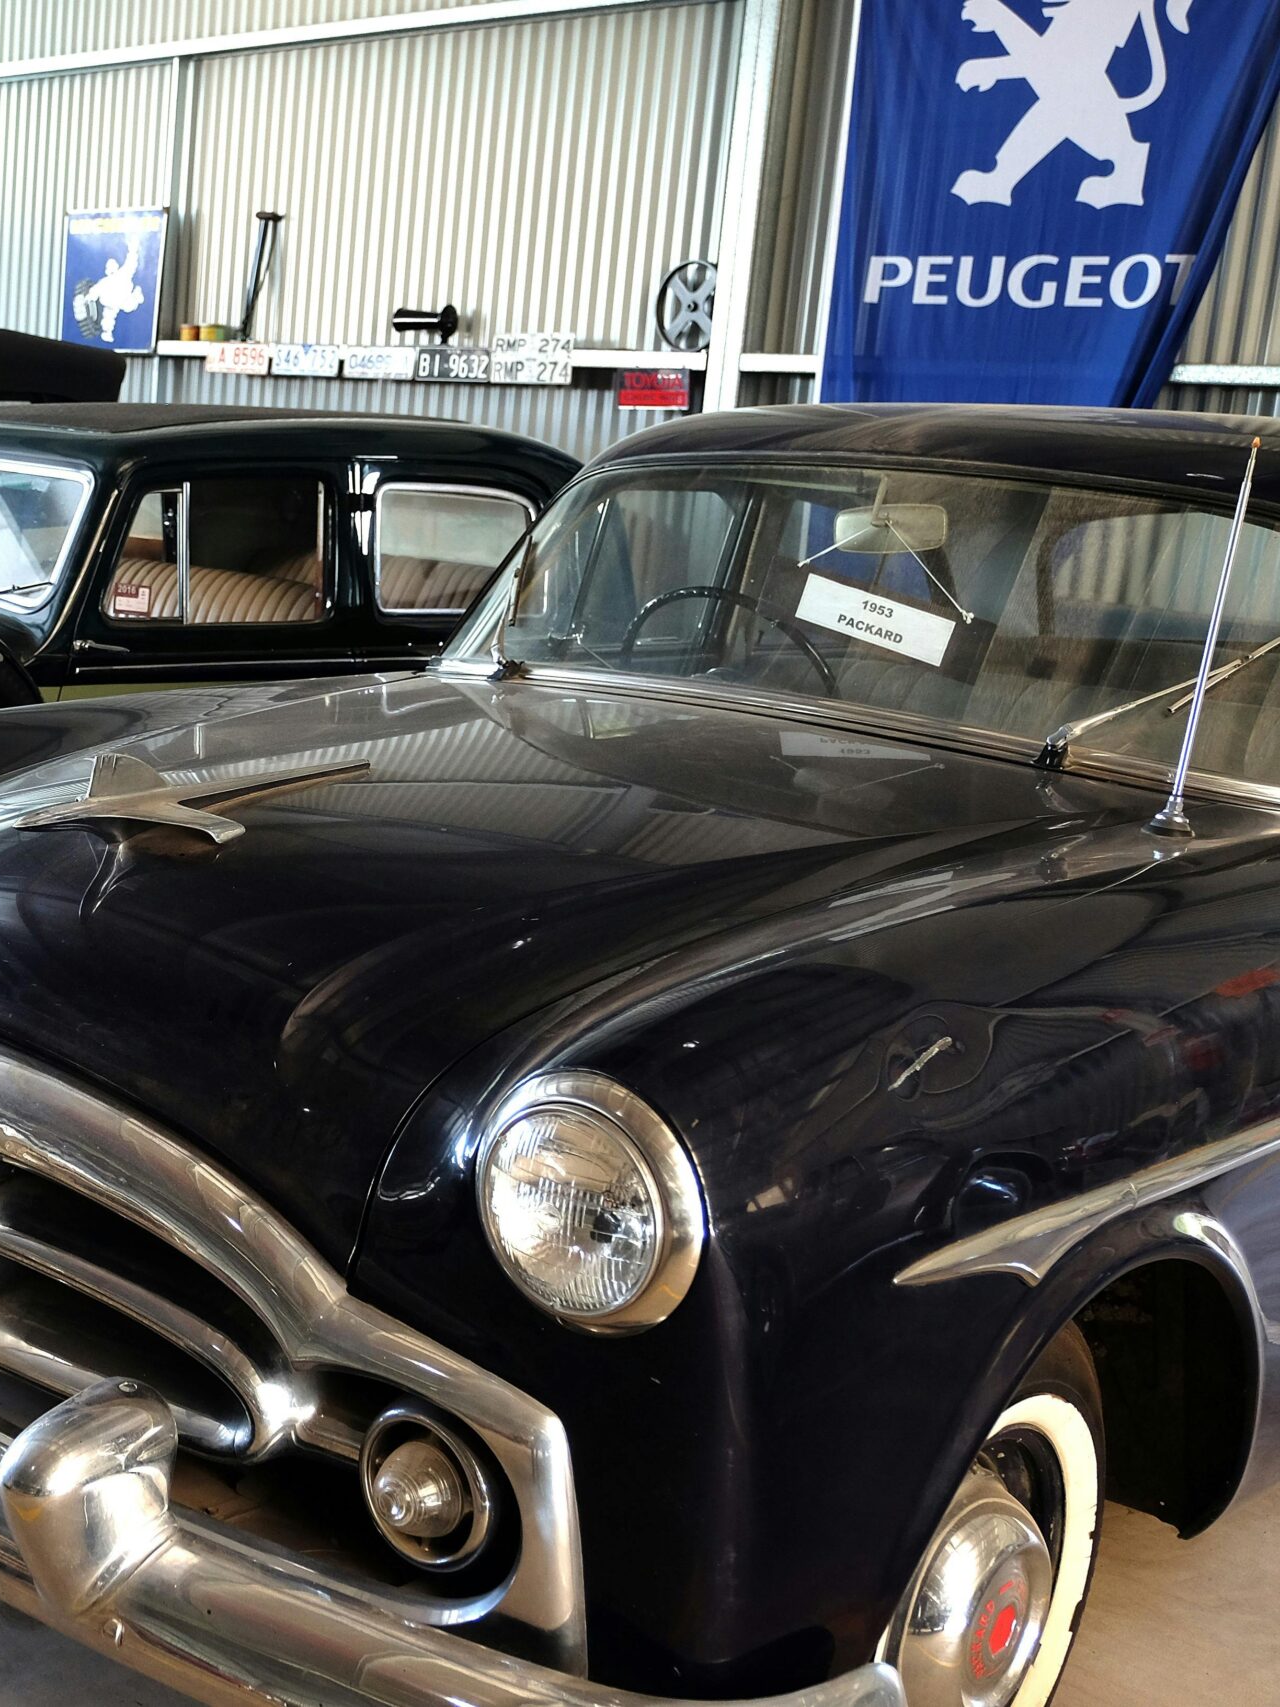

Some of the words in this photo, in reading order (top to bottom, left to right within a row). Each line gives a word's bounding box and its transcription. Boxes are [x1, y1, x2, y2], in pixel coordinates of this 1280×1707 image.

[863, 253, 1197, 310] PEUGEOT
[495, 338, 526, 351] RMP
[538, 338, 571, 353] 274
[233, 347, 265, 366] 8596
[493, 360, 524, 381] RMP
[536, 361, 569, 382] 274
[623, 372, 684, 389] TOYOTA
[862, 600, 894, 618] 1953
[837, 614, 903, 644] PACKARD
